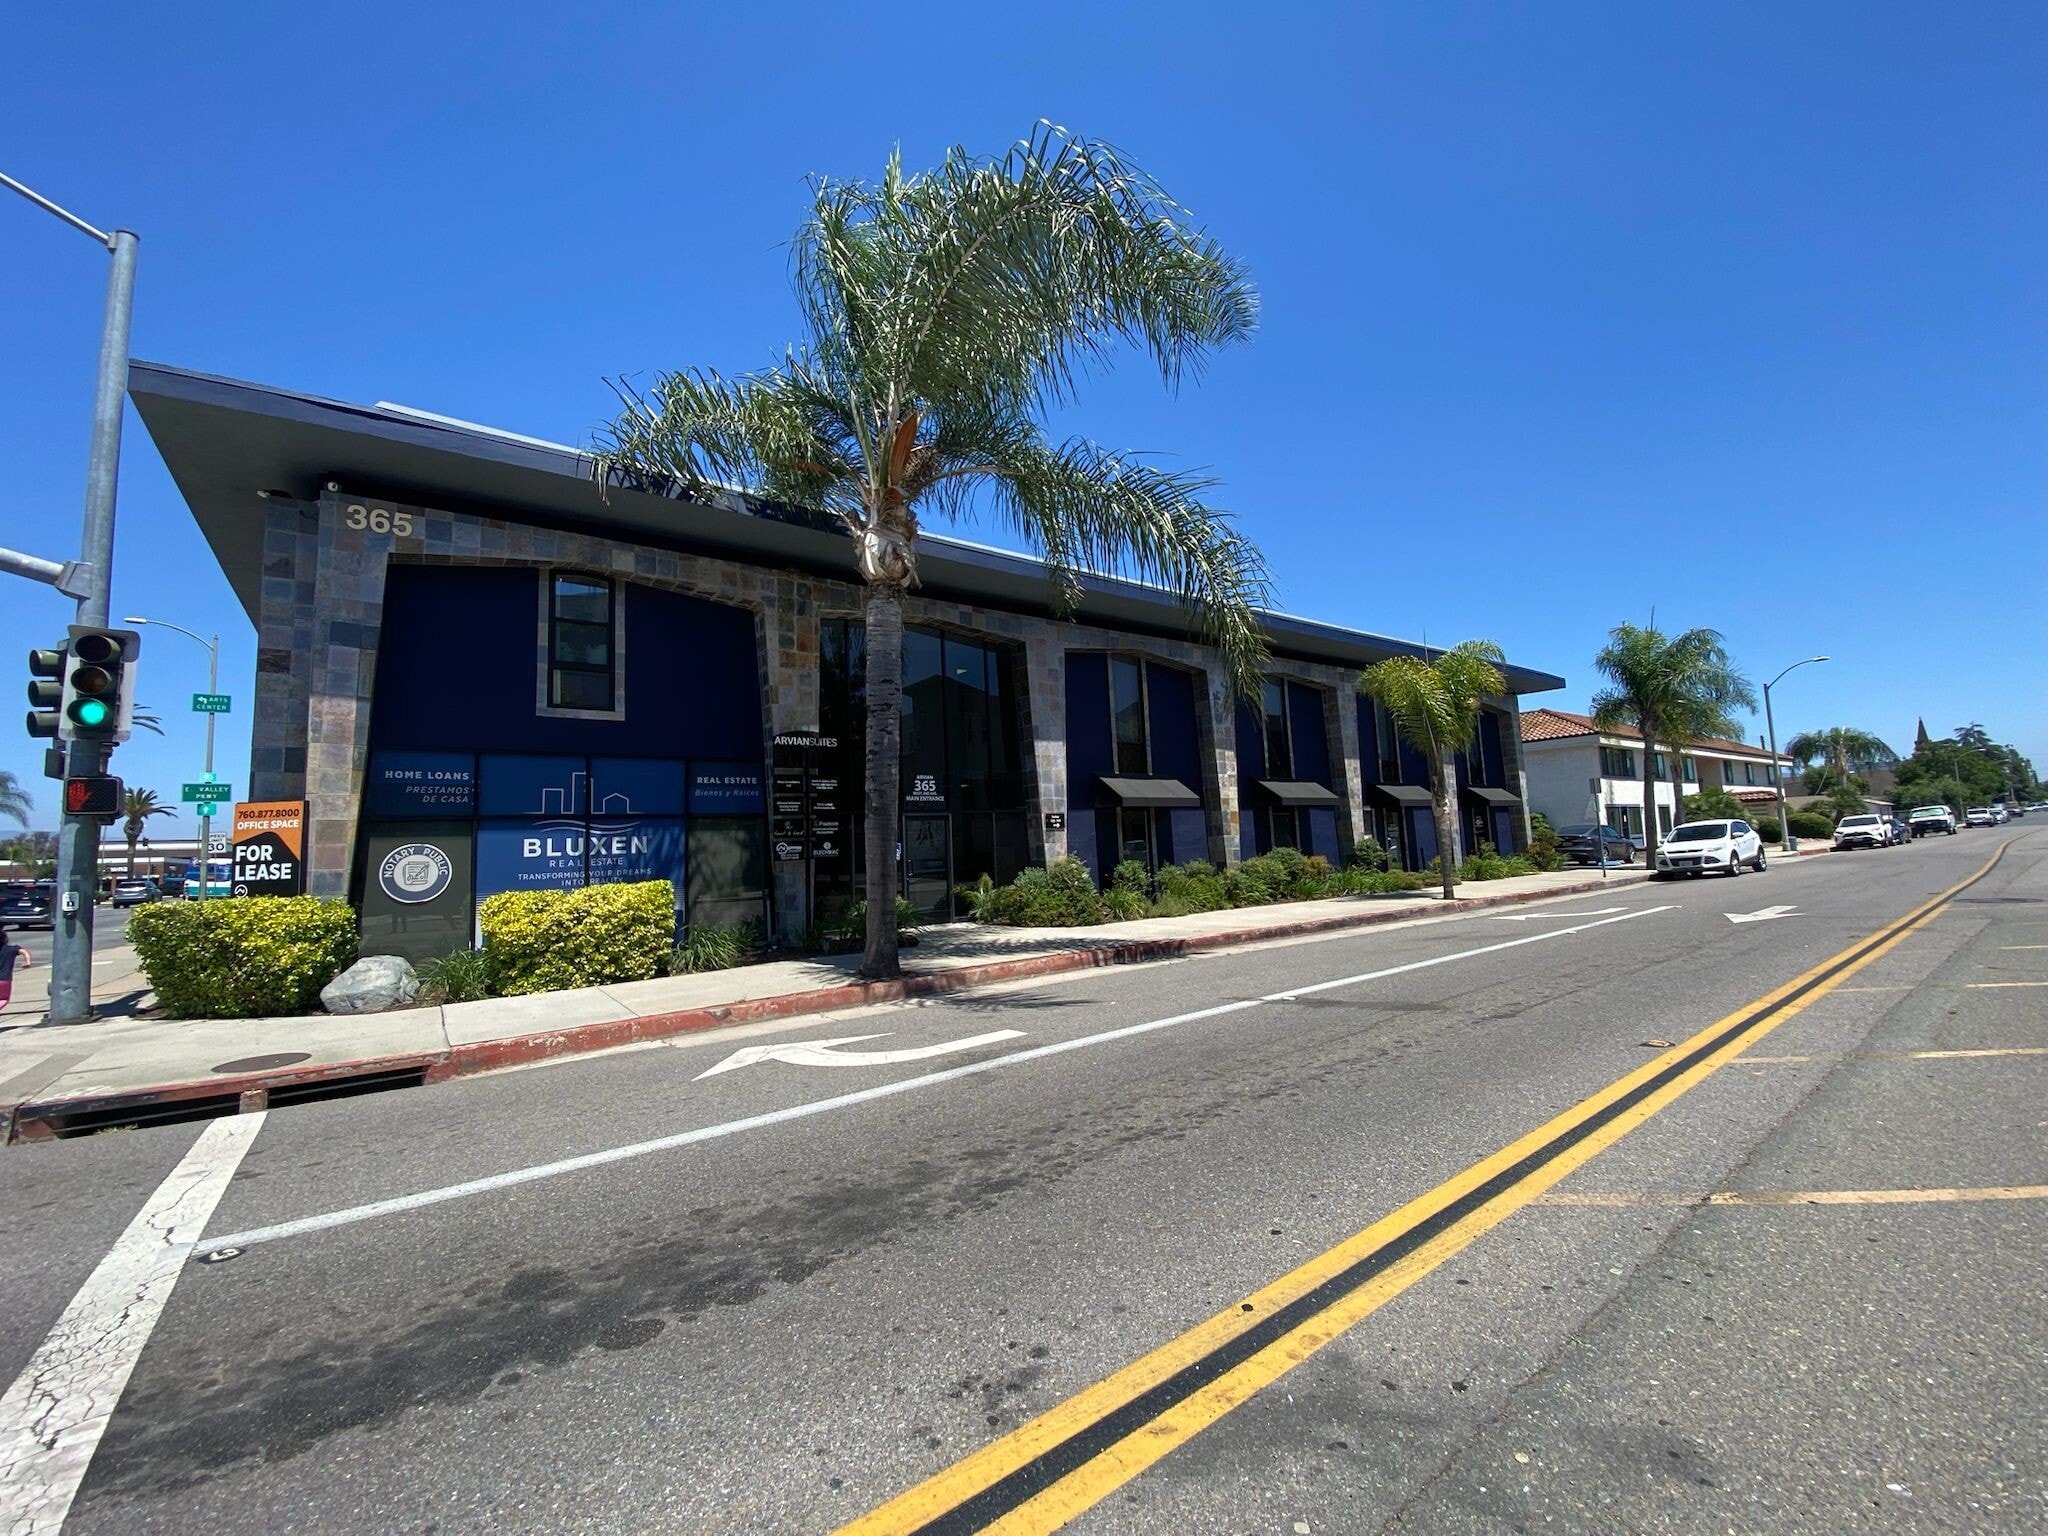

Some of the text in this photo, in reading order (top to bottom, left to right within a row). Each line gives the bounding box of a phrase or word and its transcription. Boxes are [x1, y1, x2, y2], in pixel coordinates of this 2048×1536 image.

[346, 504, 413, 537] 365
[384, 770, 469, 780] HOME LOANS
[696, 776, 722, 784] REAL
[406, 786, 470, 794] PRESTAMOS
[914, 780, 936, 792] 365
[422, 795, 469, 803] DE CASA
[238, 809, 300, 819] 760.877.8000
[237, 819, 299, 830] OFFICE SPACE
[207, 843, 225, 851] 30
[523, 835, 648, 858] BLUXEN
[235, 844, 273, 862] FOR
[383, 847, 449, 878] NOTARY PUBLIC
[549, 857, 623, 868] REAL ESTATE
[234, 862, 292, 881] LEASE
[518, 867, 652, 880] TRANSFORMING YOUR DREAMS
[590, 877, 624, 885] REALITY
